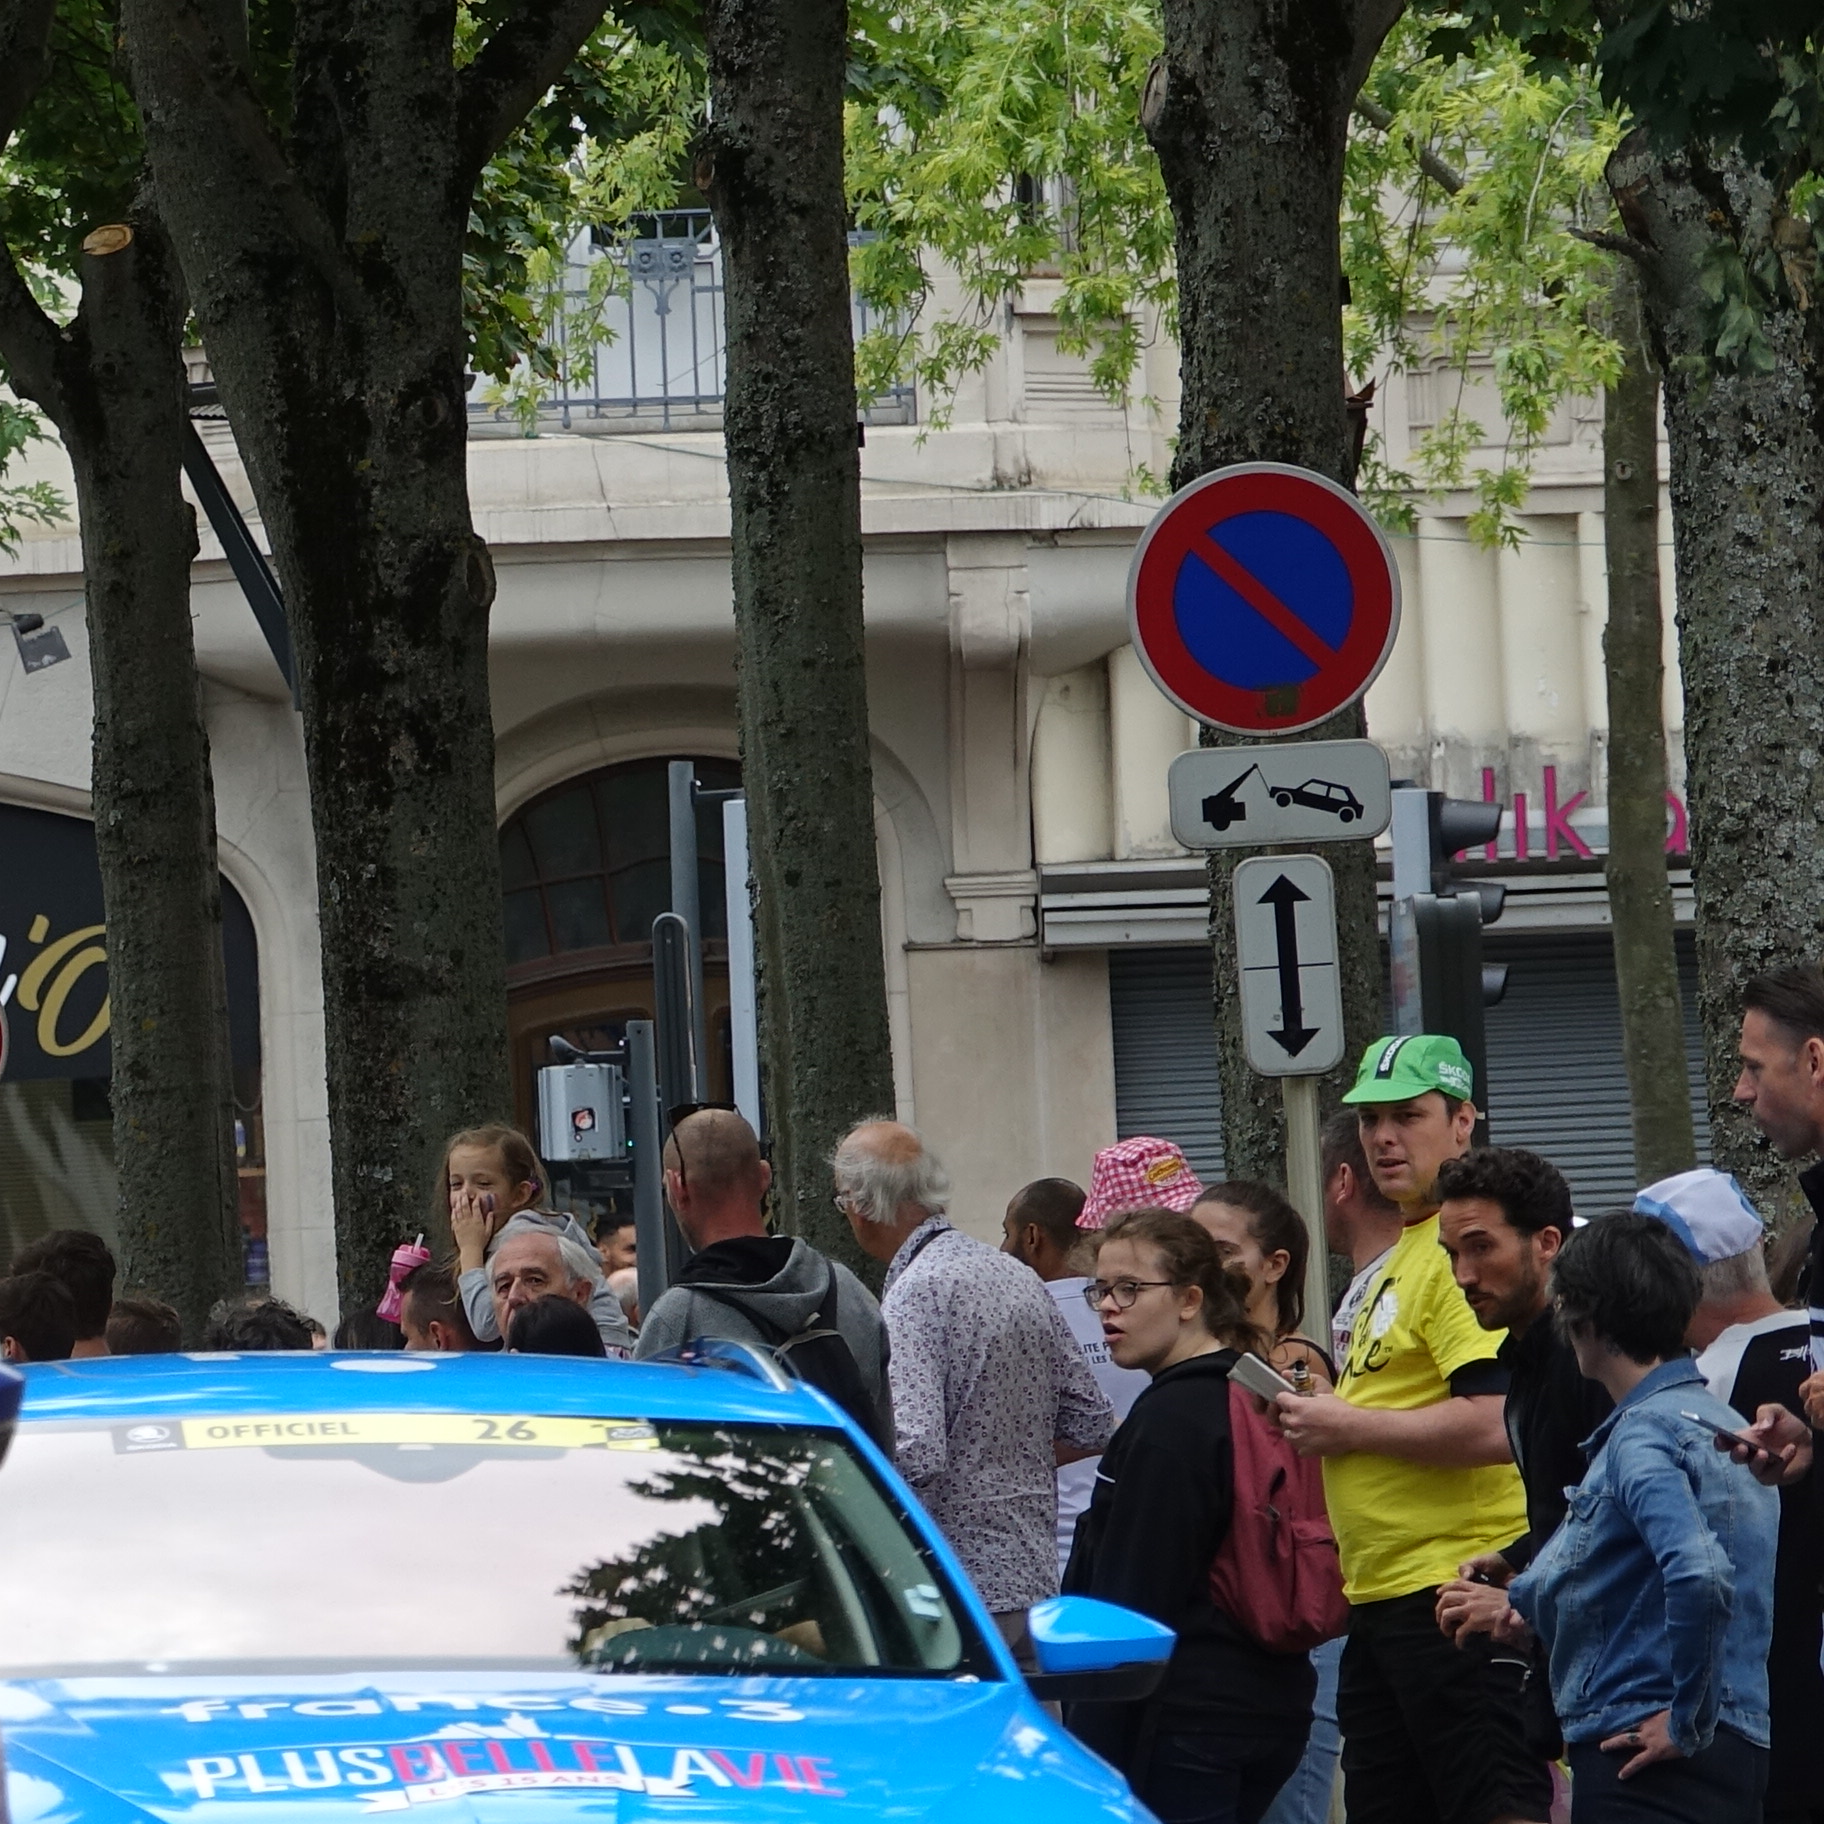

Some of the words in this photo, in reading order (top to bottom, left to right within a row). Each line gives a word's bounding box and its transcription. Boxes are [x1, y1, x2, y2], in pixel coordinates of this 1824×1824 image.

[206, 1421, 360, 1440] OFFICIEL
[471, 1419, 539, 1441] 26
[185, 1743, 395, 1799] PLUS
[387, 1739, 616, 1784] BELLE
[706, 1749, 849, 1798] VIE
[551, 1774, 623, 1786] ANS
